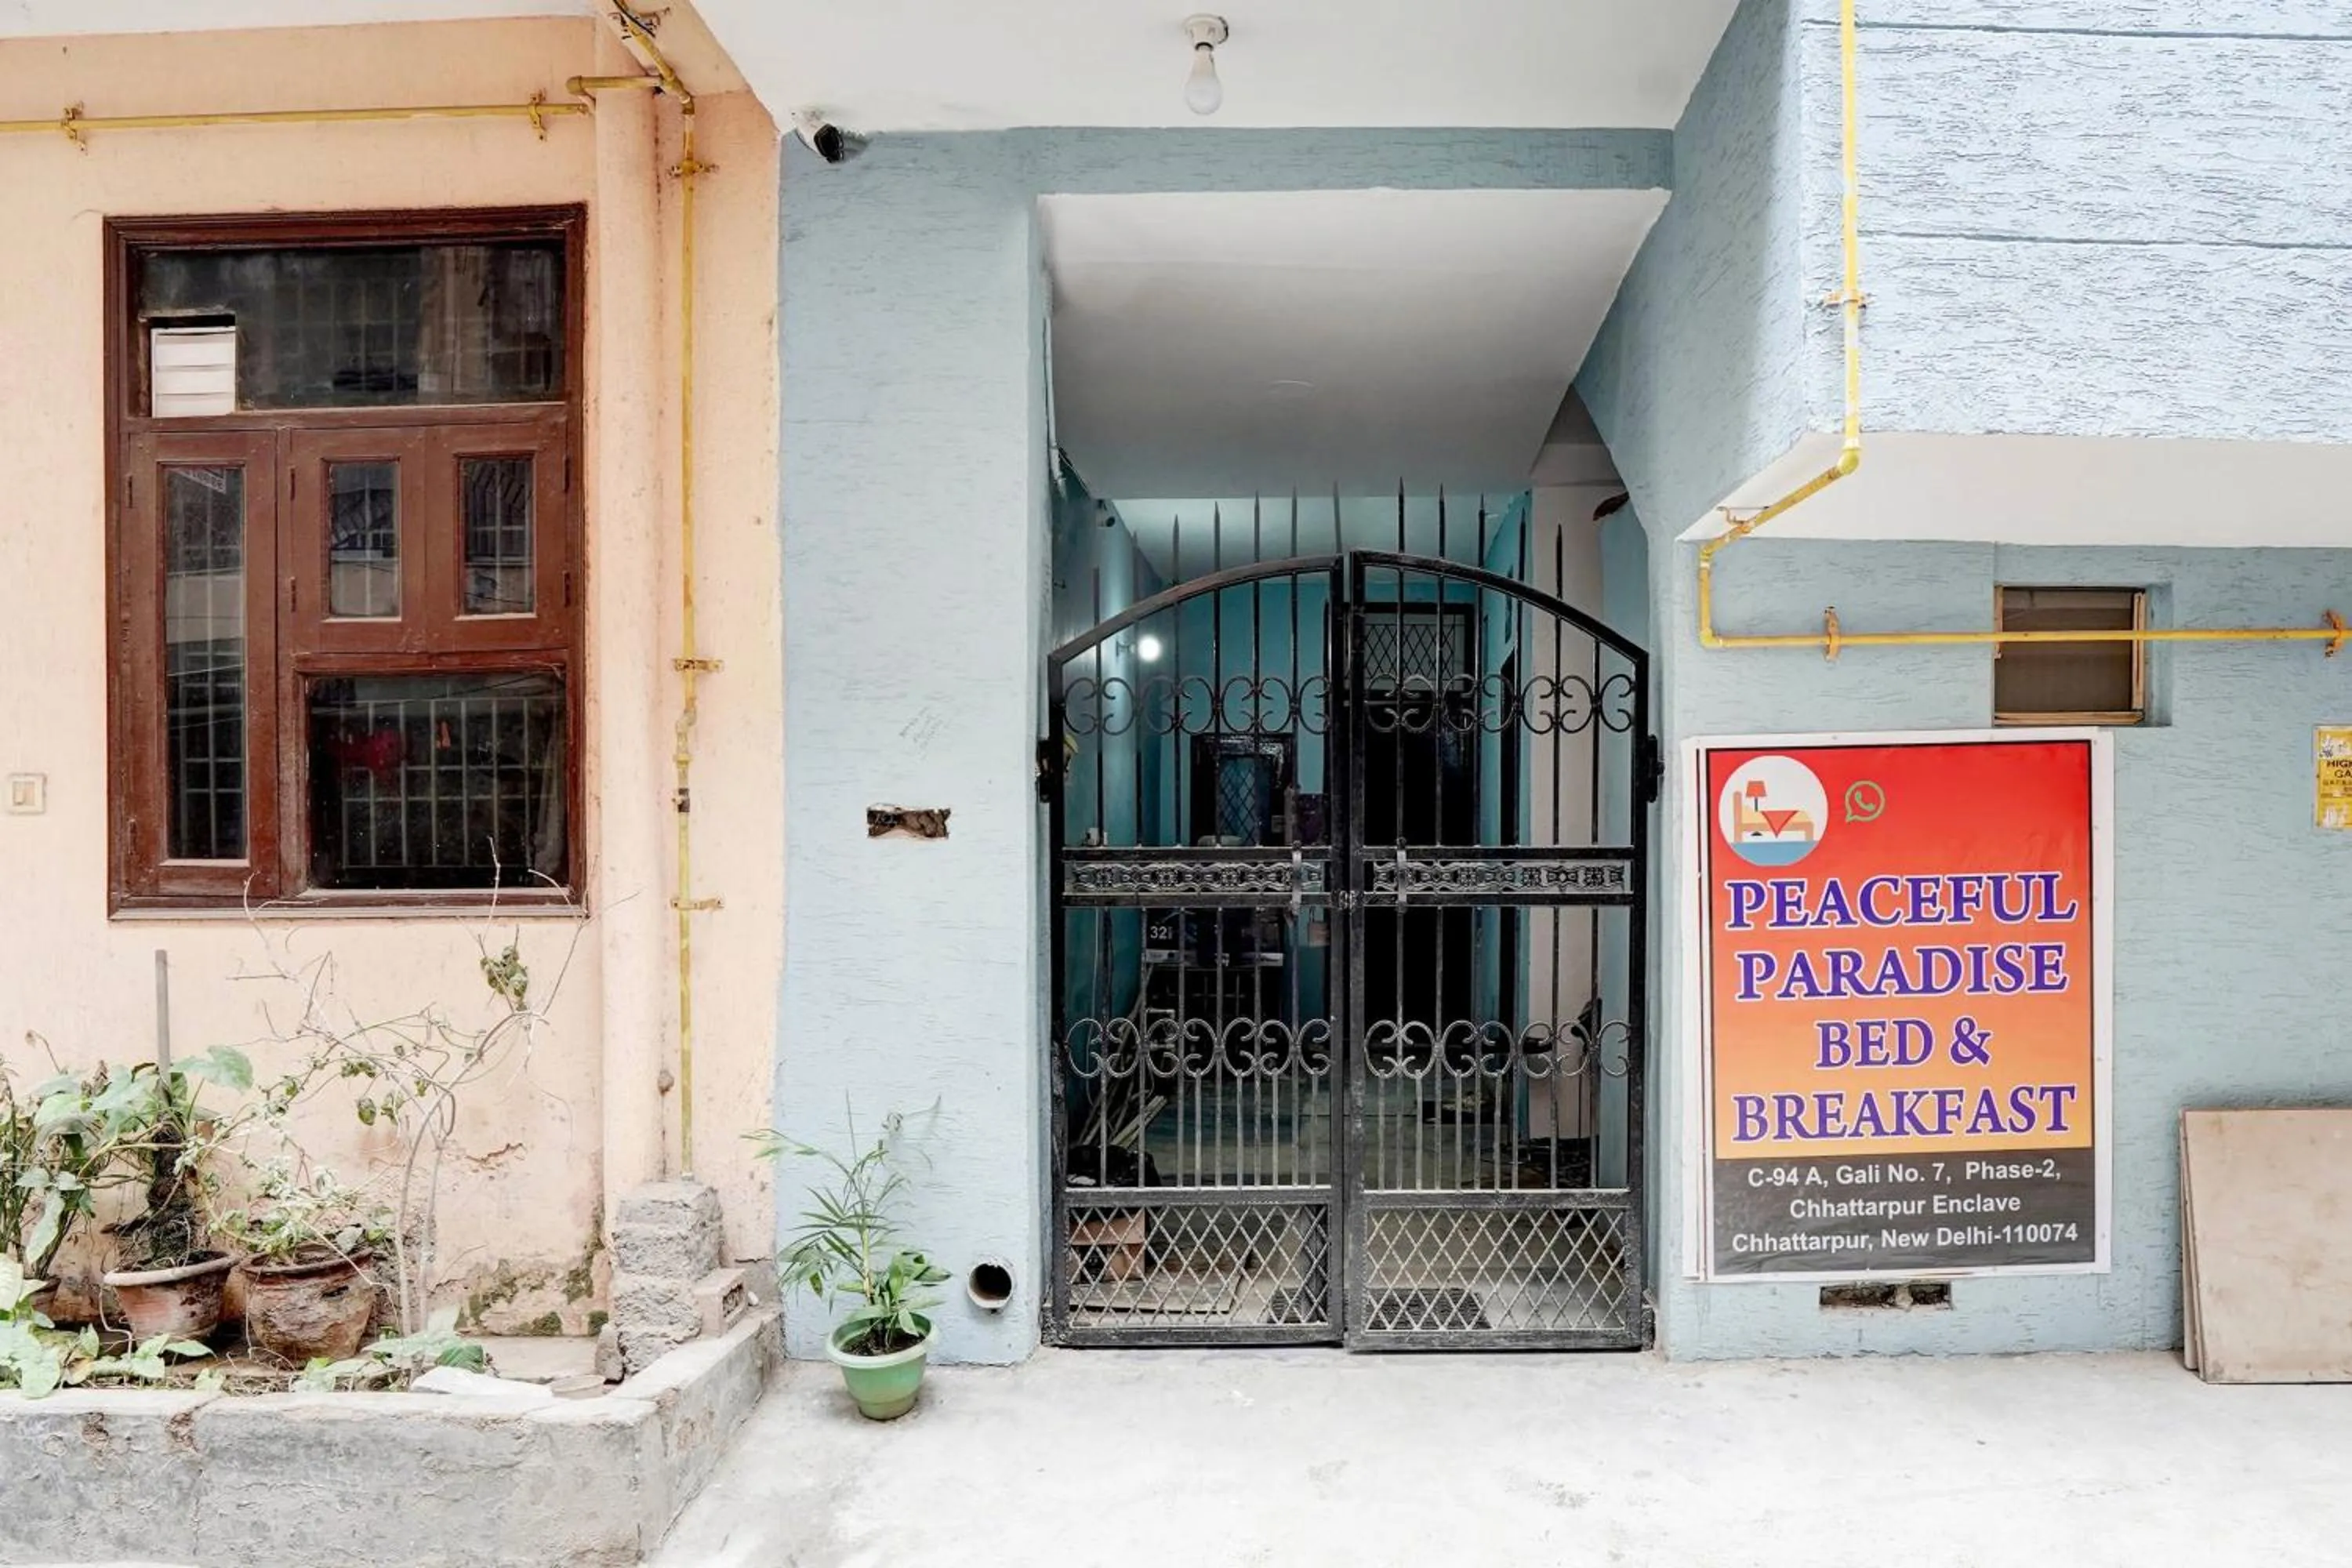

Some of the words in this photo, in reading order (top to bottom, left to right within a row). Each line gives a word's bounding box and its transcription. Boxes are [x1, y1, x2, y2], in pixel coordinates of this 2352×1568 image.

[1726, 873, 2077, 928] PEACEFUL
[1736, 944, 2067, 1000] PARADISE
[1815, 1019, 1933, 1068] BED
[1950, 1017, 1991, 1065] &
[1732, 1085, 2075, 1142] BREAKFAST
[1748, 1167, 1798, 1188] C-94
[1805, 1166, 1828, 1188] A,
[1836, 1164, 1880, 1185] Gali
[1888, 1163, 1926, 1183] No.
[1932, 1162, 1951, 1185] 7,
[1965, 1159, 2061, 1180] Phase-2,
[1790, 1198, 1926, 1219] Chhattarpur
[1933, 1193, 2020, 1214] Enclave
[1732, 1232, 1872, 1254] Chhattarpur,
[1881, 1229, 1929, 1247] New
[1936, 1222, 2078, 1247] Delhi-110074
